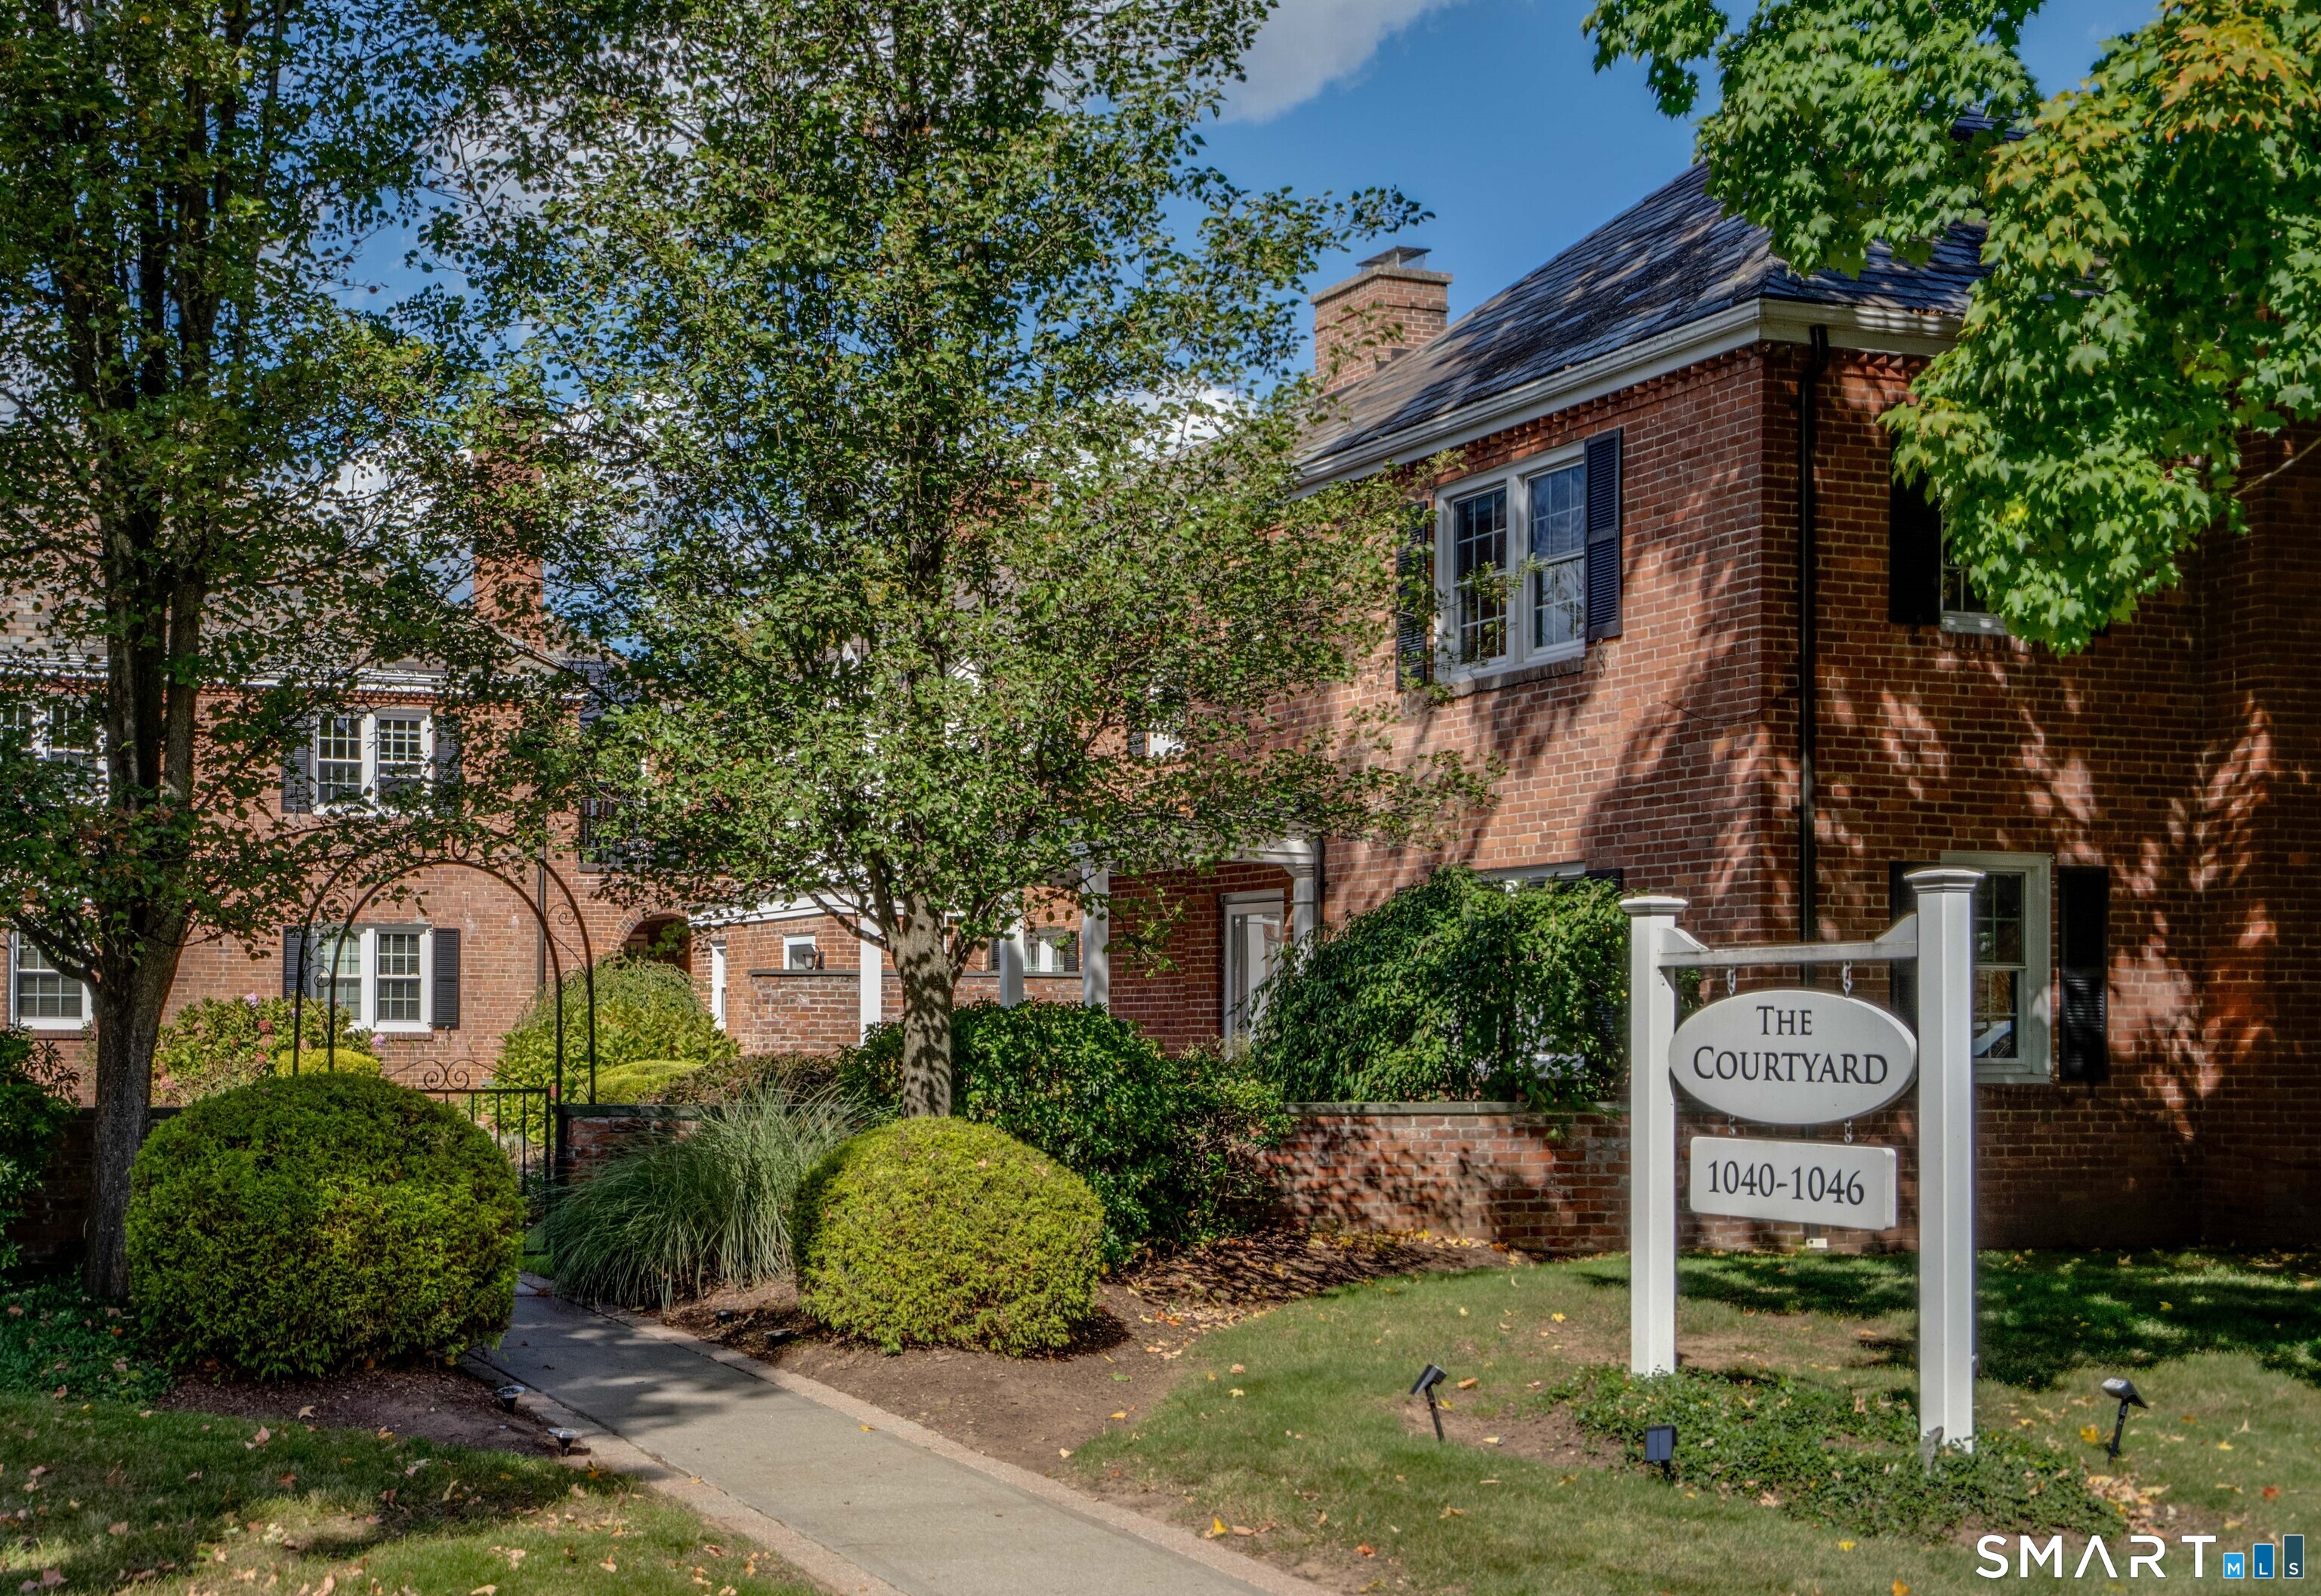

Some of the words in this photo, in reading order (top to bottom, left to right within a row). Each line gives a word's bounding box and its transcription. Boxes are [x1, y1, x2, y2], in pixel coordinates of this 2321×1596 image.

[1756, 1005, 1813, 1036] THE
[1693, 1045, 1888, 1085] COURTYARD
[1708, 1160, 1865, 1205] 1040-1046
